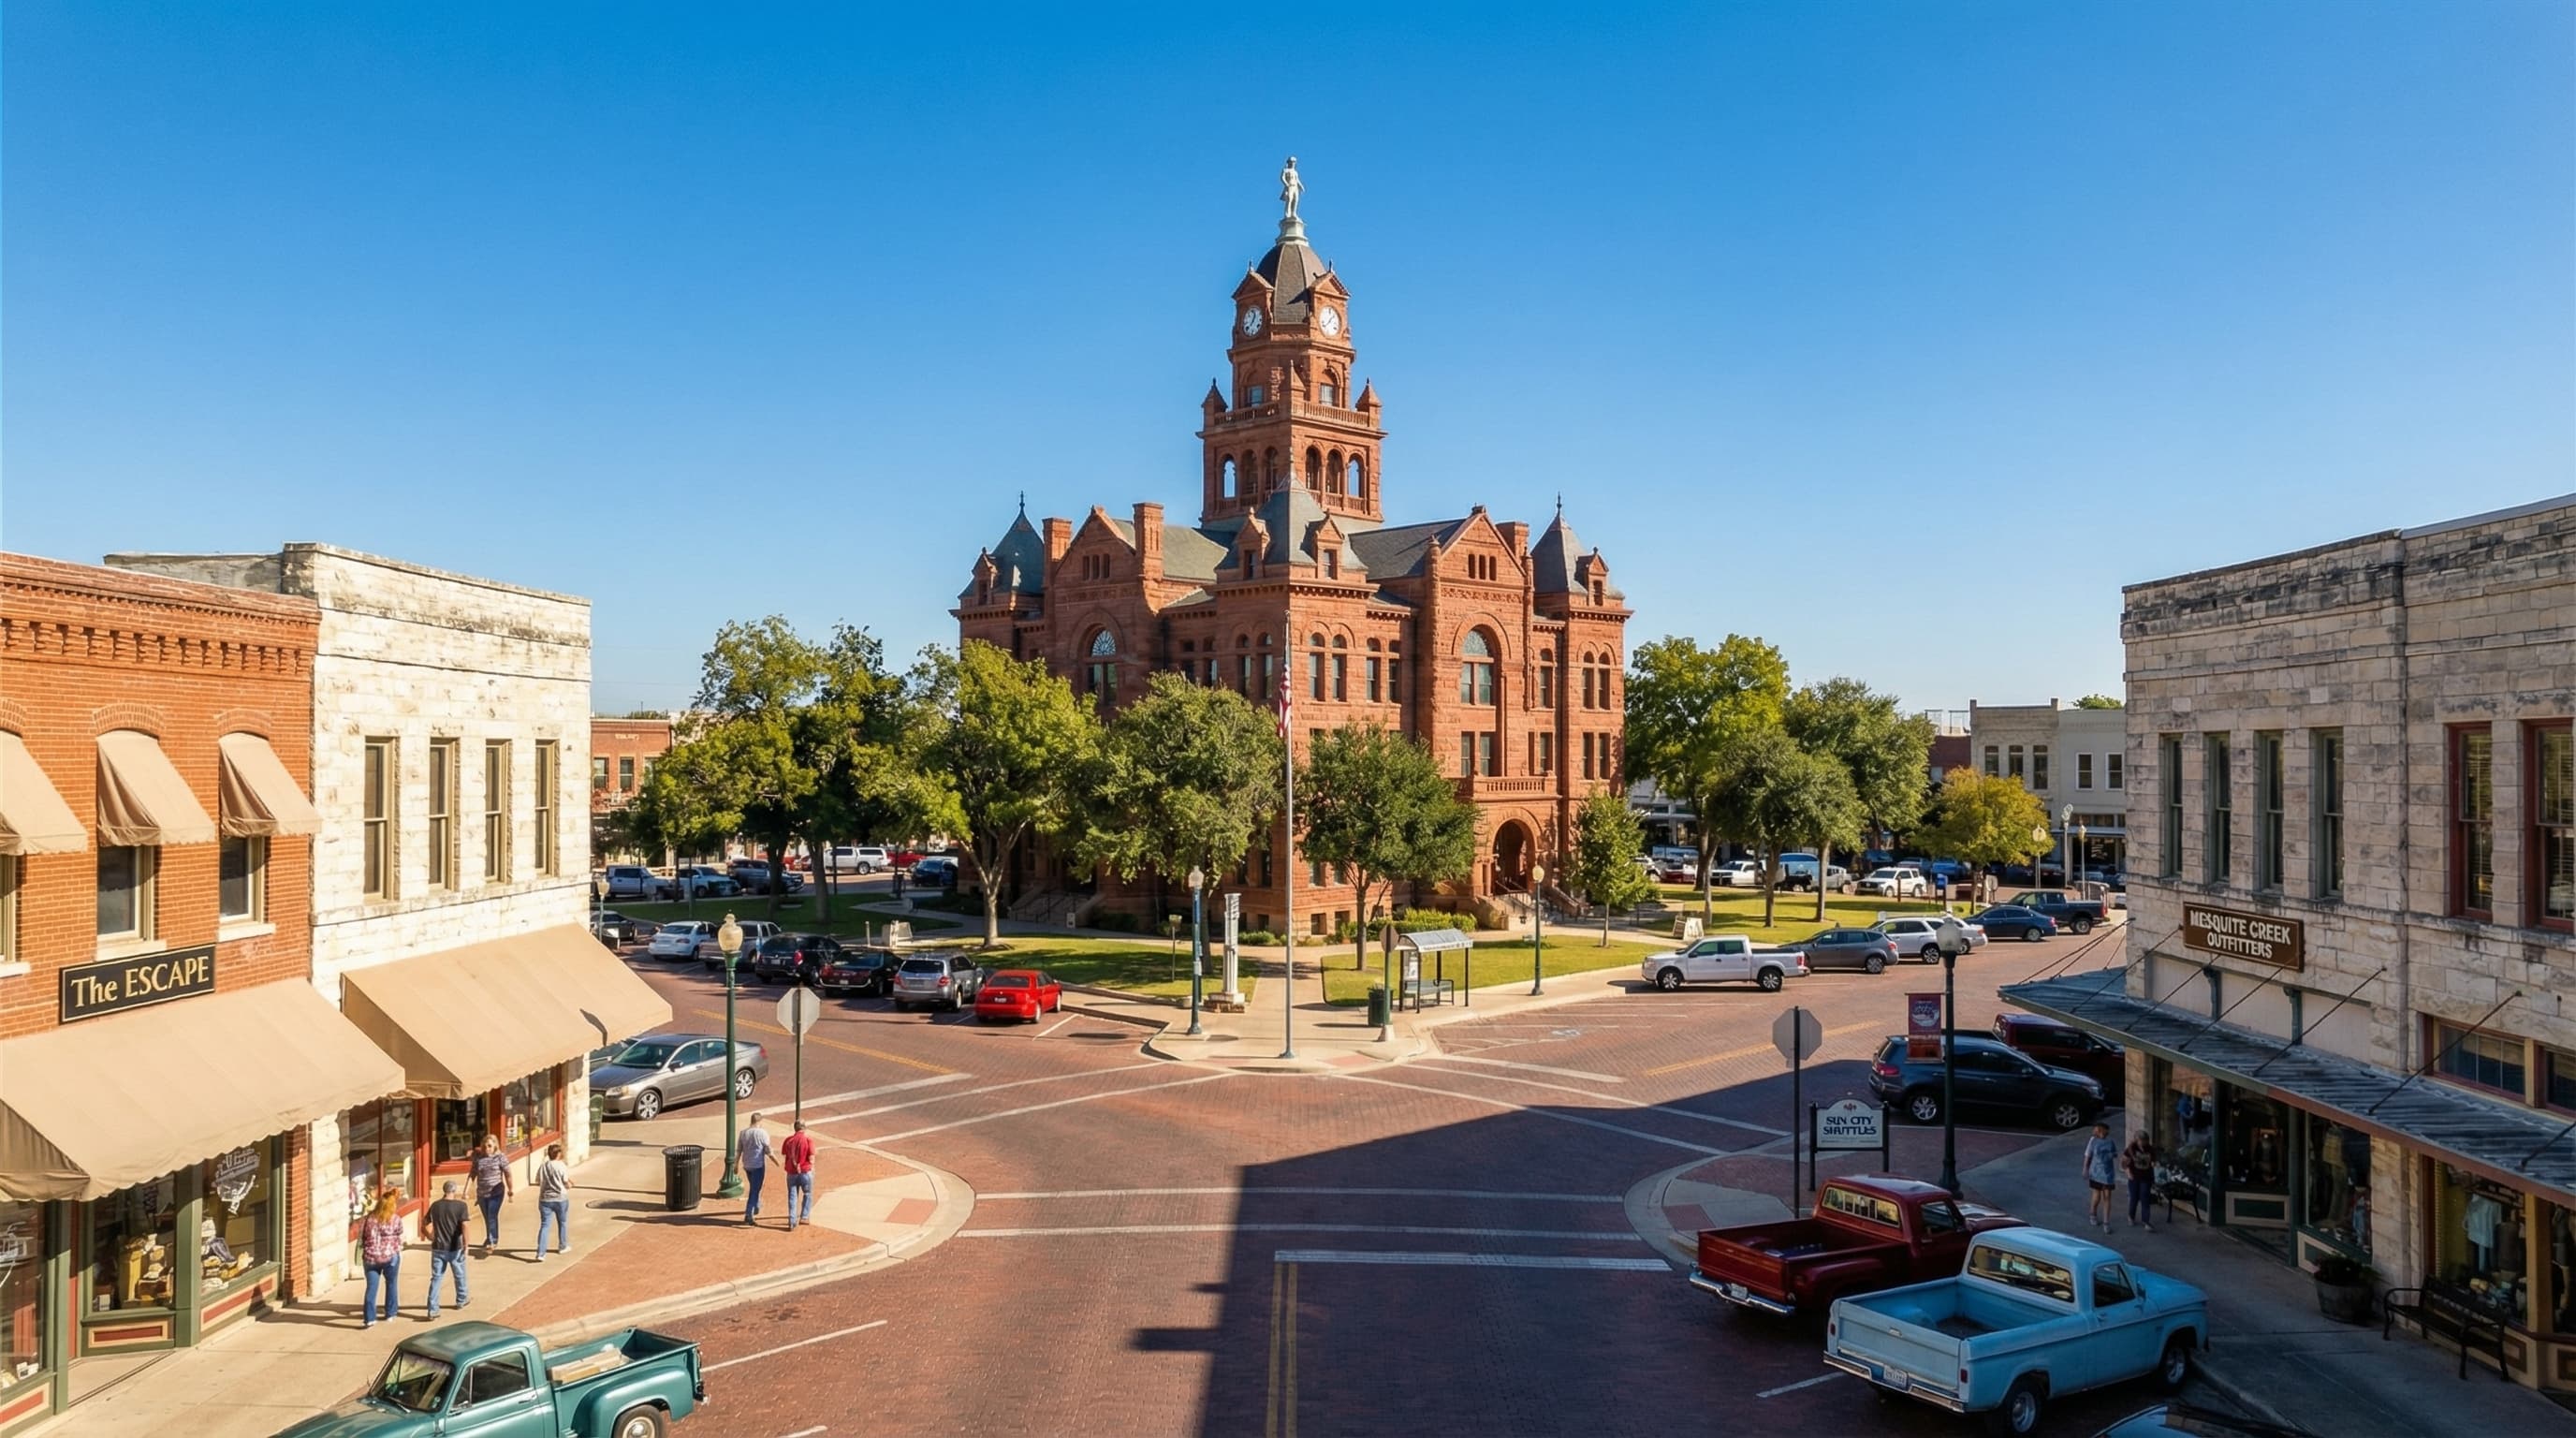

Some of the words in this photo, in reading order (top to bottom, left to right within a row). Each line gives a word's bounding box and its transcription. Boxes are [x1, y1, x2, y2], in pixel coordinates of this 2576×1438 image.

[2189, 910, 2247, 936] MESQUITE
[2249, 920, 2291, 945] CREEK
[2207, 932, 2273, 959] OUTFITTERS
[70, 976, 118, 1007] The
[124, 956, 210, 998] ESCAPE
